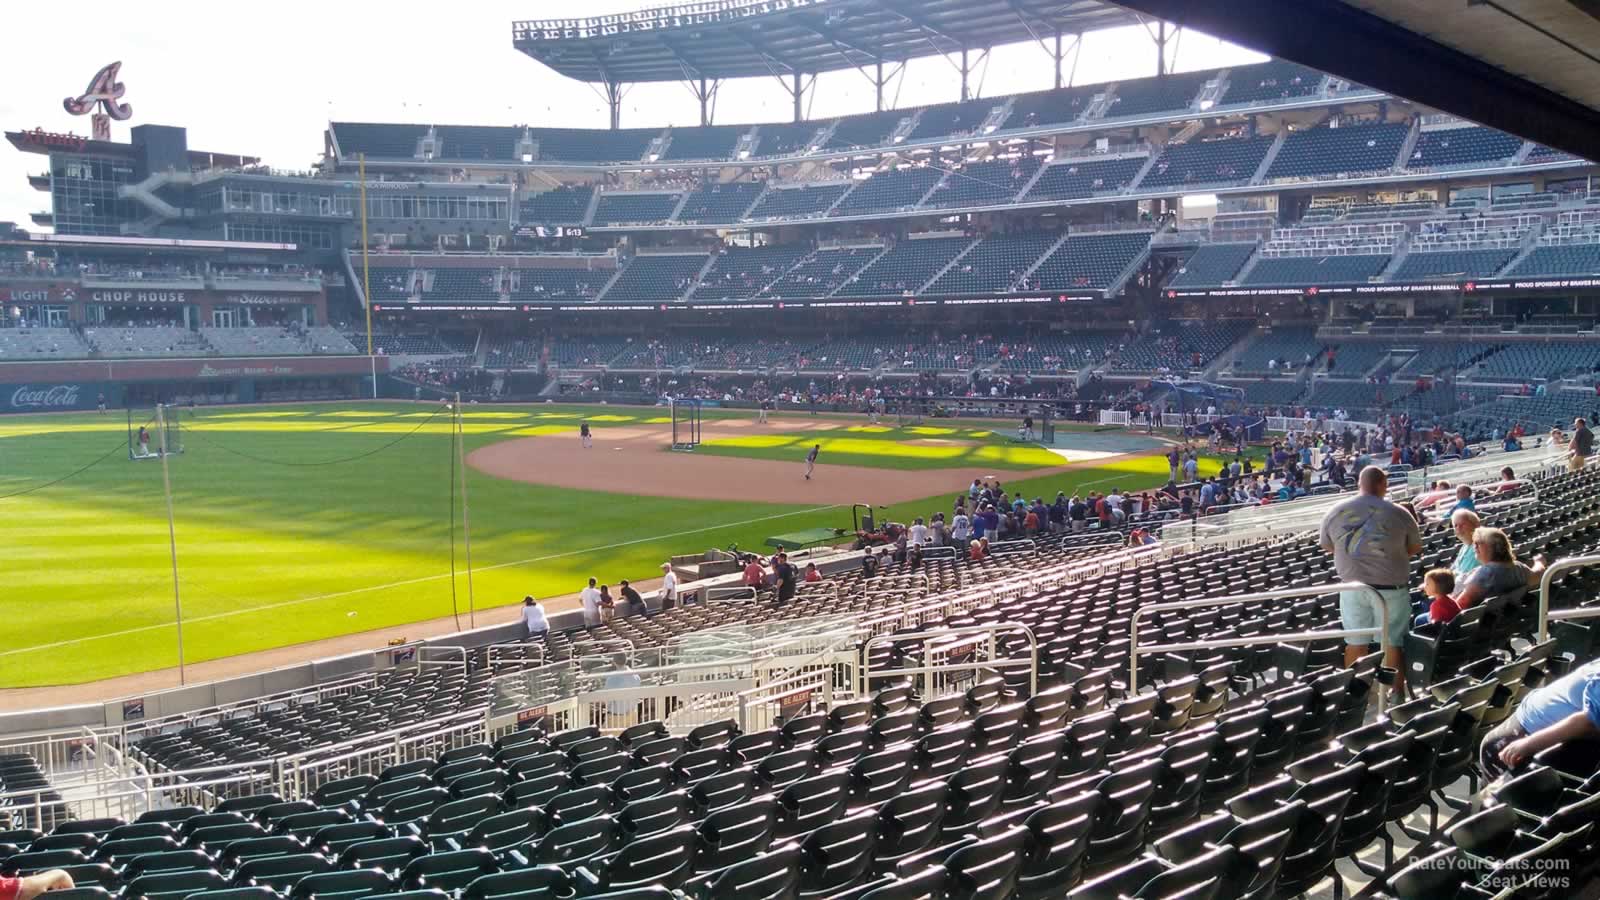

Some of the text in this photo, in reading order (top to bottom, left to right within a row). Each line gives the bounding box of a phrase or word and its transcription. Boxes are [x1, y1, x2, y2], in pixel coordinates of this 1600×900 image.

[566, 228, 582, 237] 6:13
[10, 290, 48, 301] LIGHT
[93, 292, 185, 302] CHOP HOUSE
[783, 691, 810, 705] BE ALERT
